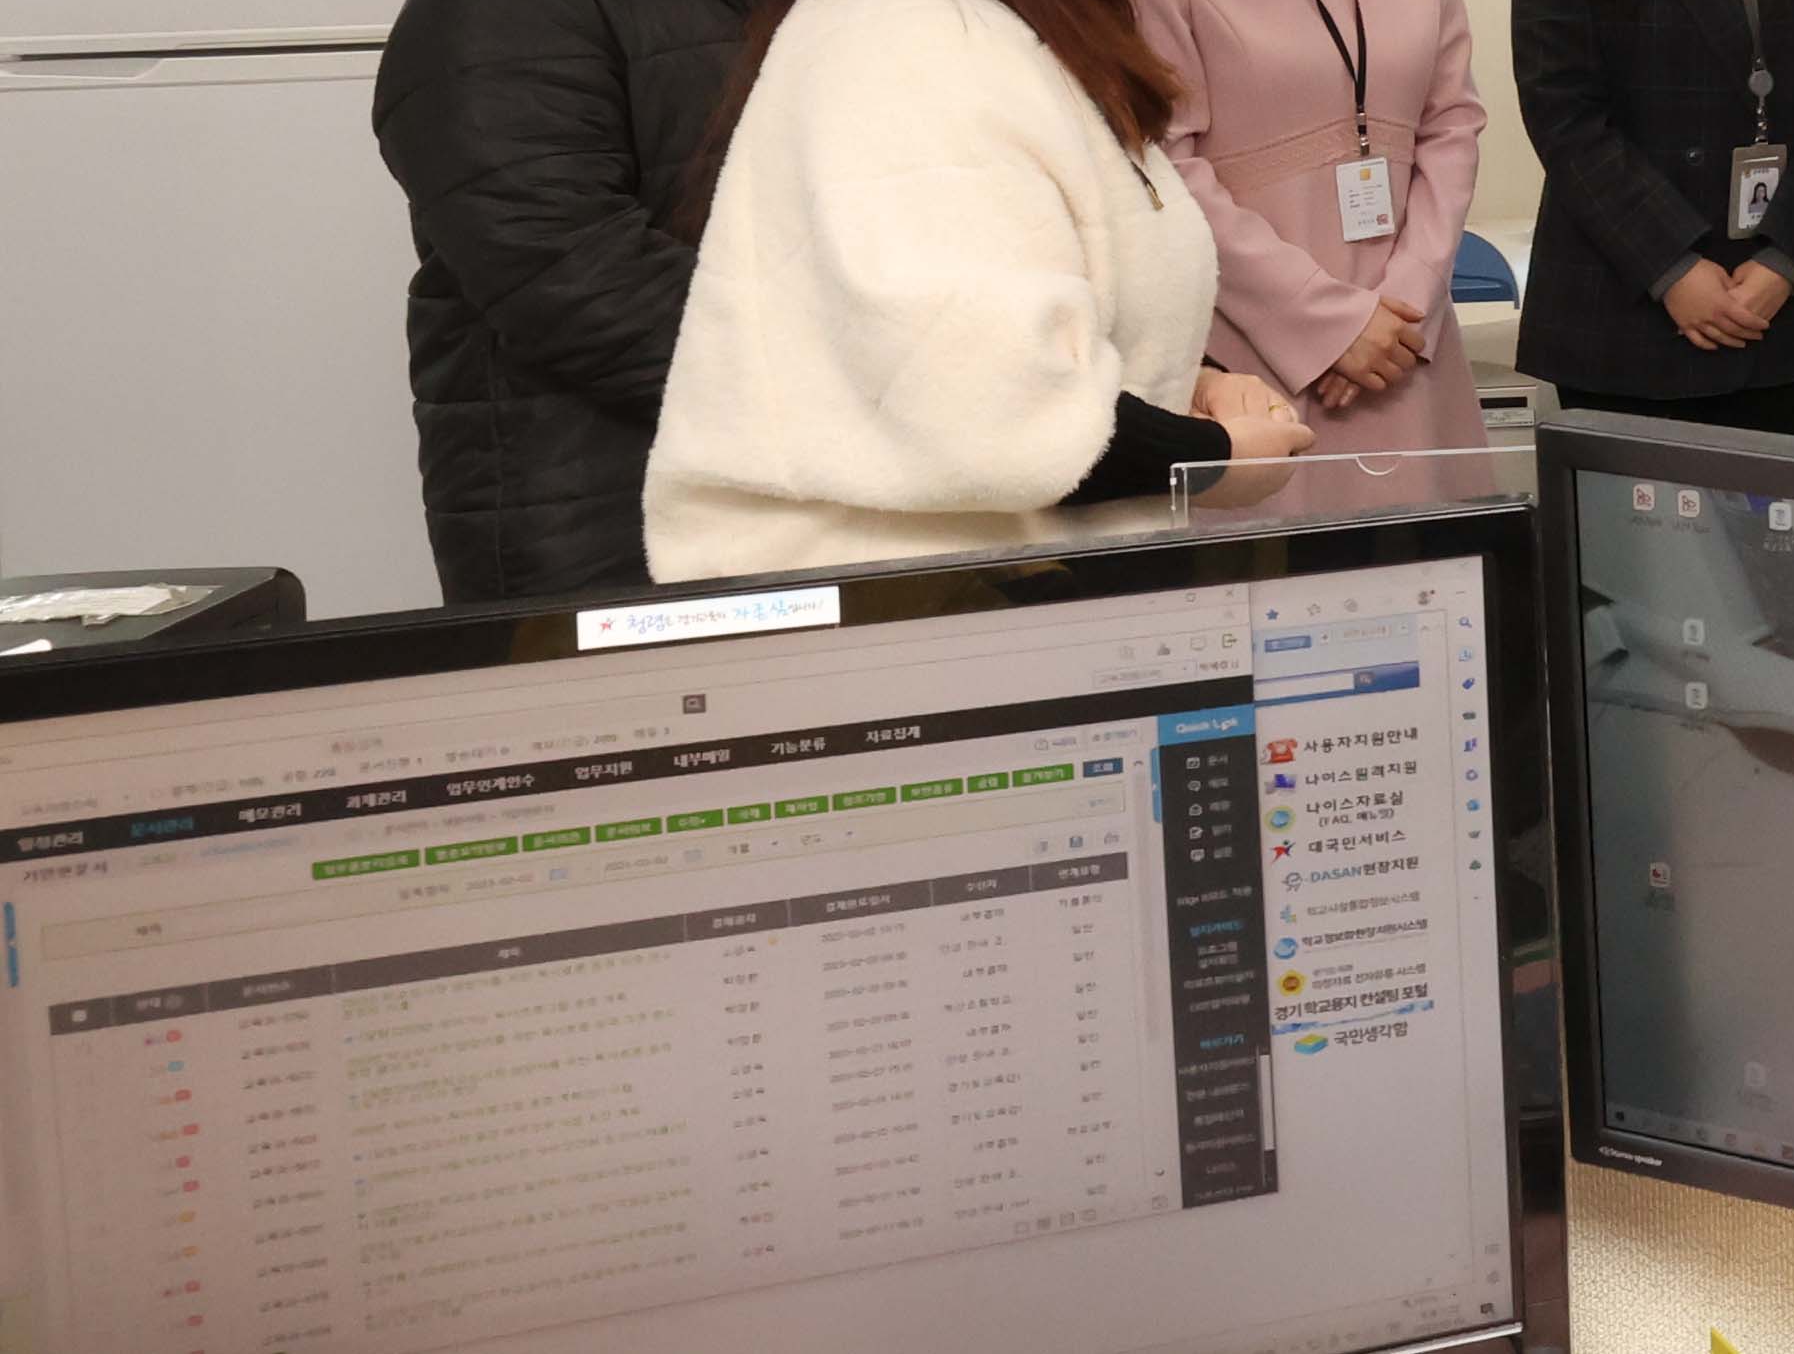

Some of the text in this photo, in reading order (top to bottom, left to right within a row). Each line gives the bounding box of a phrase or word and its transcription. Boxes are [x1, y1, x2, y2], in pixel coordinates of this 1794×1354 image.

[1304, 727, 1418, 753] 사용자지원안내
[574, 760, 632, 781] 업무지원
[673, 748, 731, 768] 내부메일
[771, 737, 826, 755] 기능분류
[865, 725, 921, 744] 자료집계
[1306, 761, 1417, 785] 나이스원격지원
[1306, 791, 1403, 814] 나이스자료실
[1308, 830, 1406, 853] 대국민서비스
[1274, 1004, 1302, 1021] 경기
[1304, 997, 1357, 1016] 학교용지
[1360, 988, 1399, 1007] 컨설팅
[1334, 1021, 1408, 1046] 국민생각함
